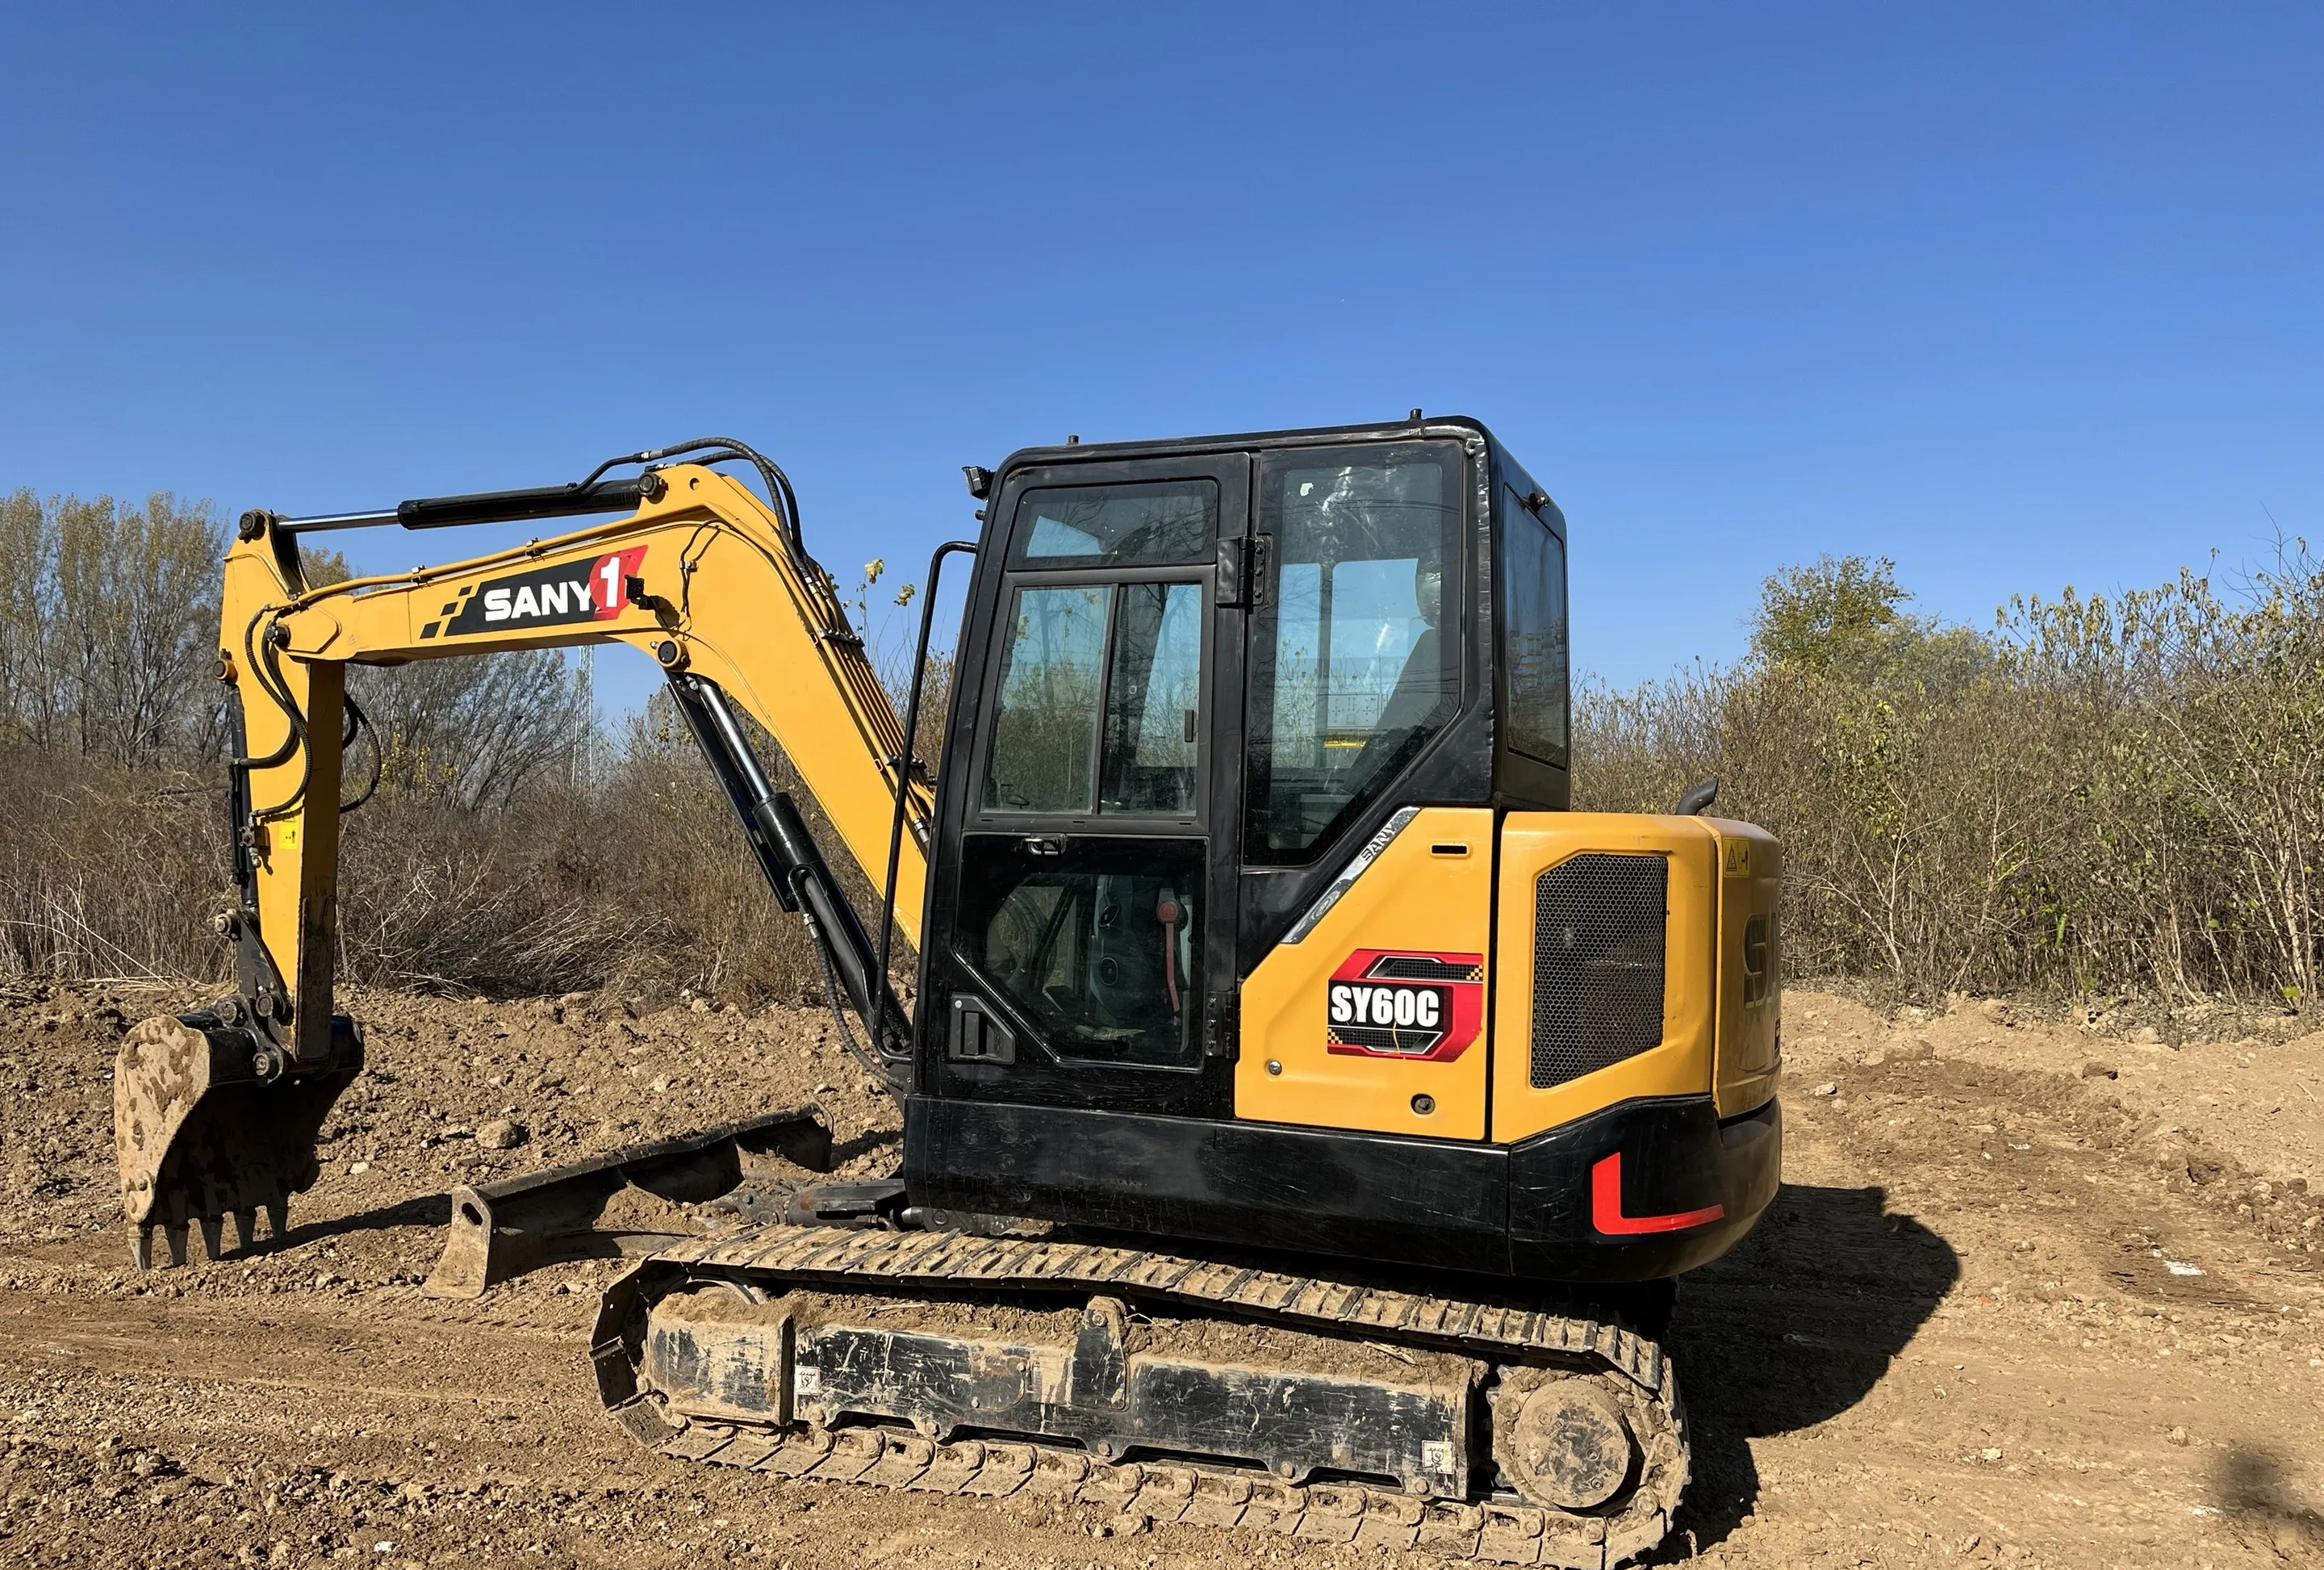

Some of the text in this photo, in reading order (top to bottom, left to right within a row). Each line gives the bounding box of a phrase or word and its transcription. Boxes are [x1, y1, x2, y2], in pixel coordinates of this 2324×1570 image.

[484, 580, 591, 622] SANY
[1361, 825, 1395, 861] SANY
[1331, 986, 1439, 1028] SY60C
